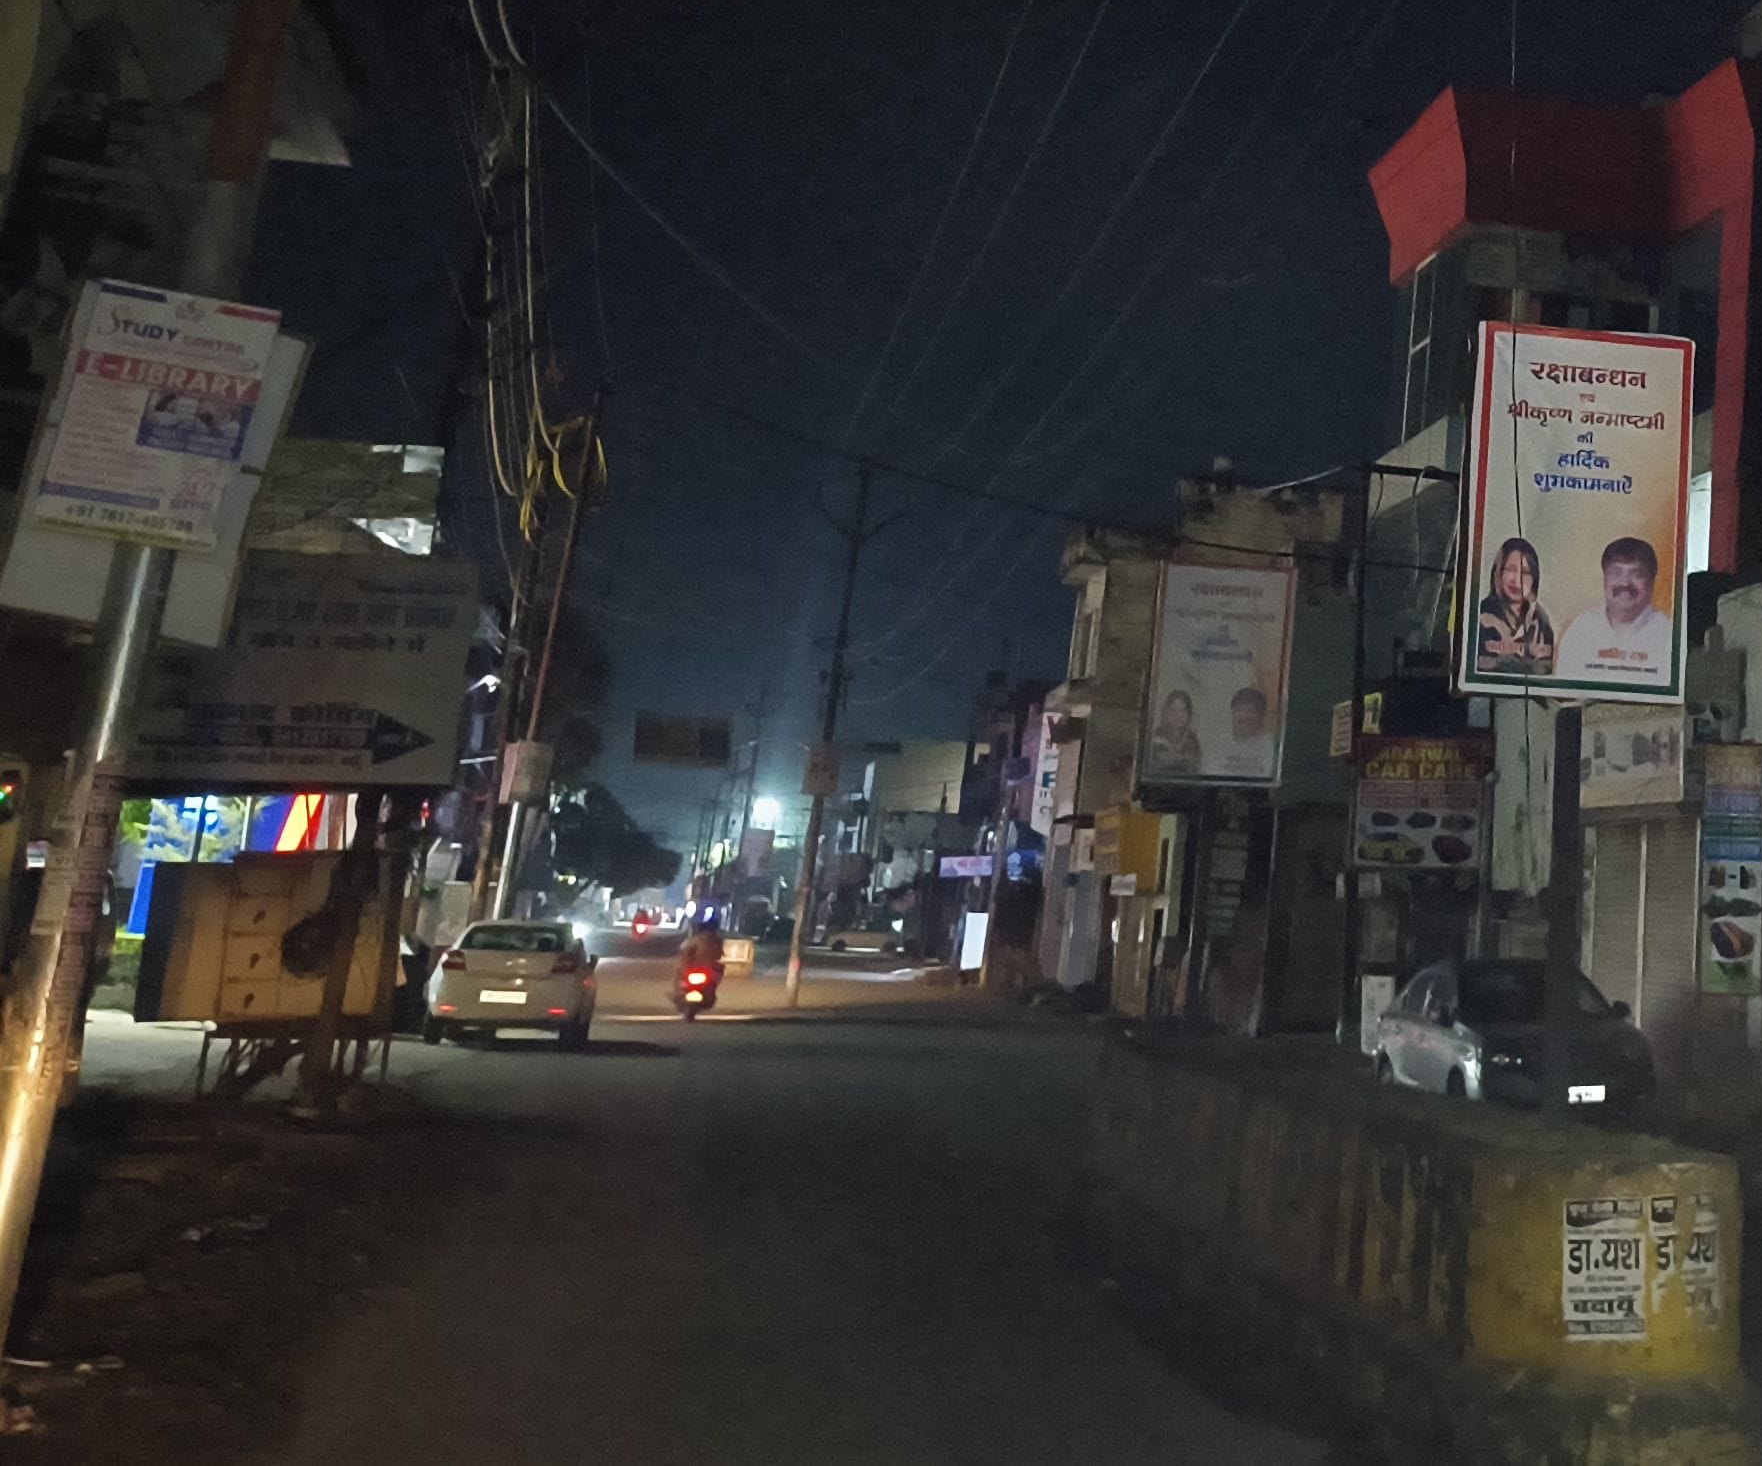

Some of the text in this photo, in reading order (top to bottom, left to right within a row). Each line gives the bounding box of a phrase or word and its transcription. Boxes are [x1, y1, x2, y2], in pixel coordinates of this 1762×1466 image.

[84, 351, 253, 401] E-LIBRARY
[1529, 362, 1647, 389] रक्षाबन्धन
[1508, 399, 1574, 427] श्रीकृष्ण
[1557, 448, 1612, 469] हार्दिक
[1365, 762, 1477, 780] CAR CARE
